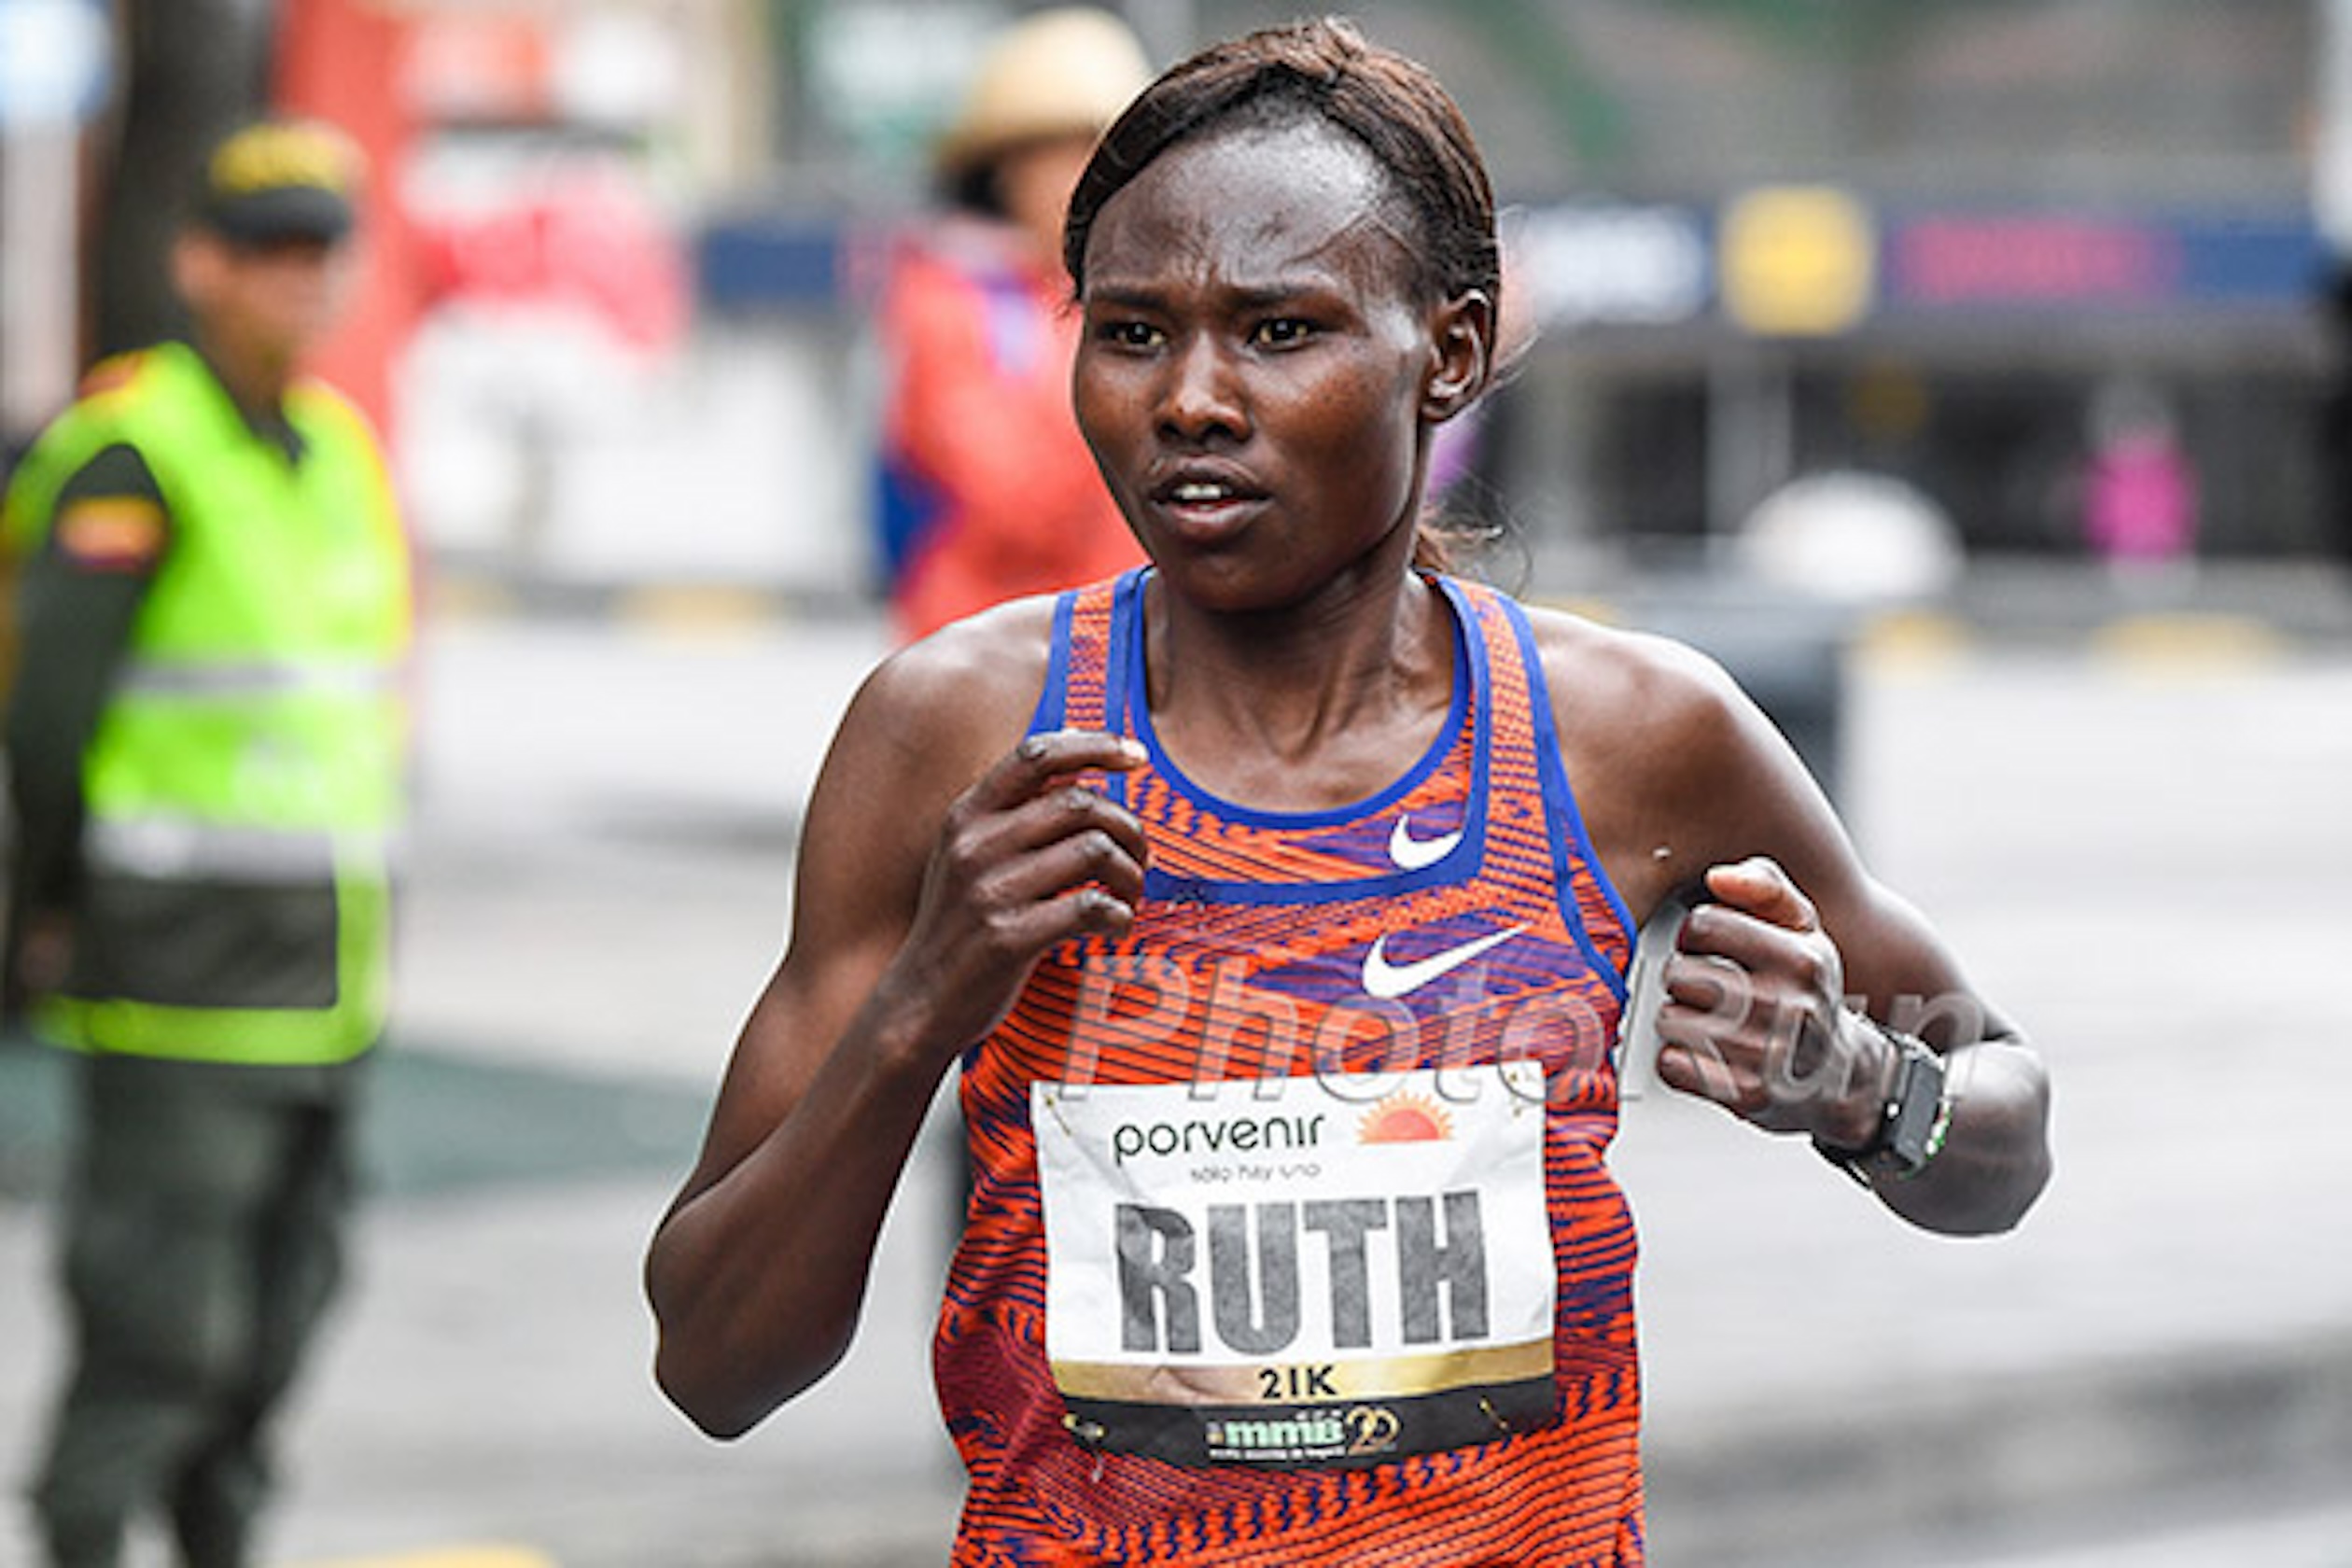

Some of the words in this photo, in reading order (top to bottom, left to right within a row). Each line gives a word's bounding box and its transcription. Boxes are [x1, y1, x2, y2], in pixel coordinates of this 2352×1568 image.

[1113, 1113, 1324, 1167] porvenir
[1115, 1190, 1490, 1356] RUTH
[1259, 1365, 1337, 1399] 21K
